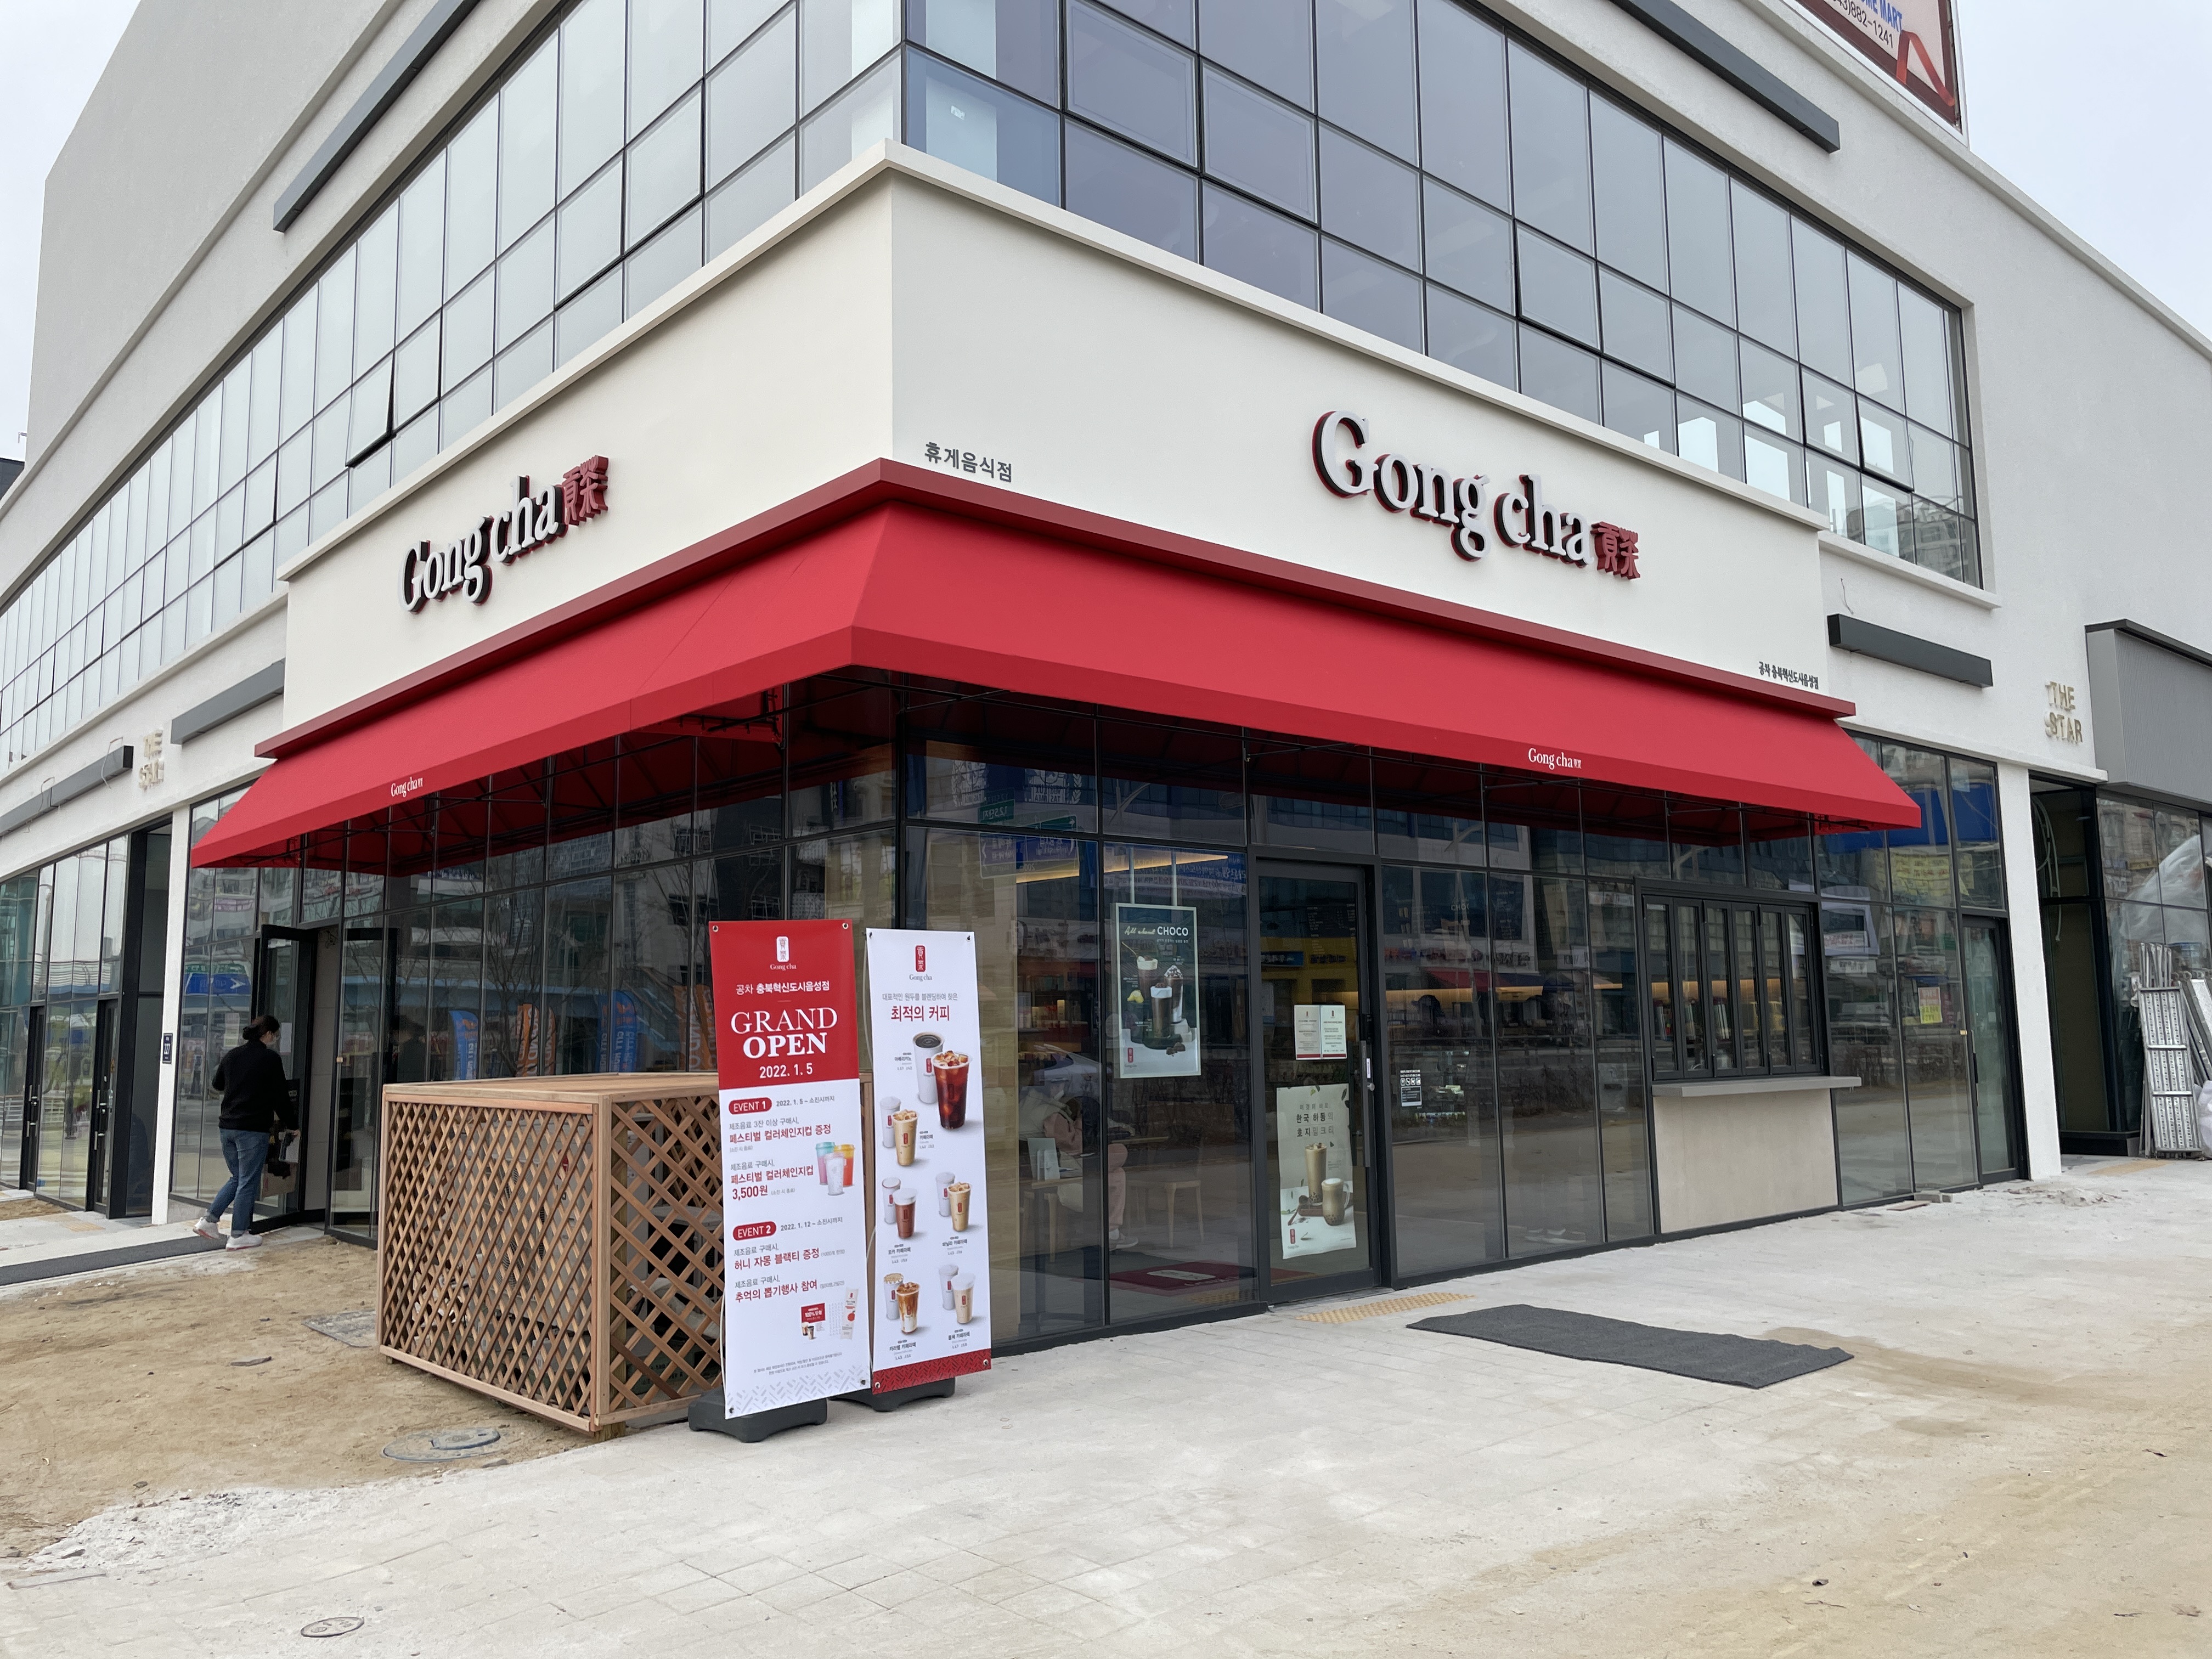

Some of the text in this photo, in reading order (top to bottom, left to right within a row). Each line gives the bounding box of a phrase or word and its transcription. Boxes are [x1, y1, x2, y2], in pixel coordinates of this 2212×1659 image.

[1880, 0, 1902, 32] MART
[924, 442, 1012, 483] 휴게음식점
[1312, 411, 1492, 561] Gong
[1493, 474, 1595, 567] cha
[399, 516, 494, 614] Gong
[490, 475, 568, 565] cha
[1758, 661, 1819, 690] 공차 충북혁신도시음성점
[2045, 681, 2076, 712] THE
[2044, 712, 2084, 744] STAR
[1528, 748, 1555, 770] Gong
[1556, 752, 1573, 768] cha
[391, 782, 407, 797] Gong
[407, 776, 417, 792] cha
[1125, 926, 1137, 935] All
[1157, 926, 1189, 936] CHOCO
[736, 980, 830, 995] 공차 충북혁신도시음성점
[882, 993, 903, 1001] 대표적인
[730, 1007, 838, 1034] GRAND
[891, 1005, 950, 1022] 최적의 커피
[743, 1032, 827, 1059] OPEN
[759, 1063, 813, 1079] 2022. 1. 5
[733, 1101, 766, 1112] EVENT 1
[729, 1121, 752, 1130] 제조음료
[765, 1119, 778, 1127] 이상
[1296, 1112, 1333, 1124] 한국 하동의
[730, 1124, 831, 1144] 페스티벌 컬러체인지컵 증정
[1297, 1126, 1334, 1137] 호지밀크티
[731, 1162, 753, 1170] 제조음료
[731, 1165, 814, 1184] 페스티벌 컬러체인지컵
[732, 1185, 768, 1201] 3,500원
[817, 1217, 843, 1226] 소진시까지
[737, 1225, 771, 1238] EVENT 2
[734, 1247, 757, 1256] 제조음료
[735, 1258, 751, 1271] 허니
[754, 1255, 771, 1266] 자몽
[775, 1251, 799, 1264] 블랙티
[803, 1248, 819, 1260] 증정
[735, 1279, 758, 1289] 제조음료
[736, 1289, 761, 1302] 추억의
[764, 1282, 798, 1298] 뽑기행사
[801, 1279, 817, 1291] 참여
